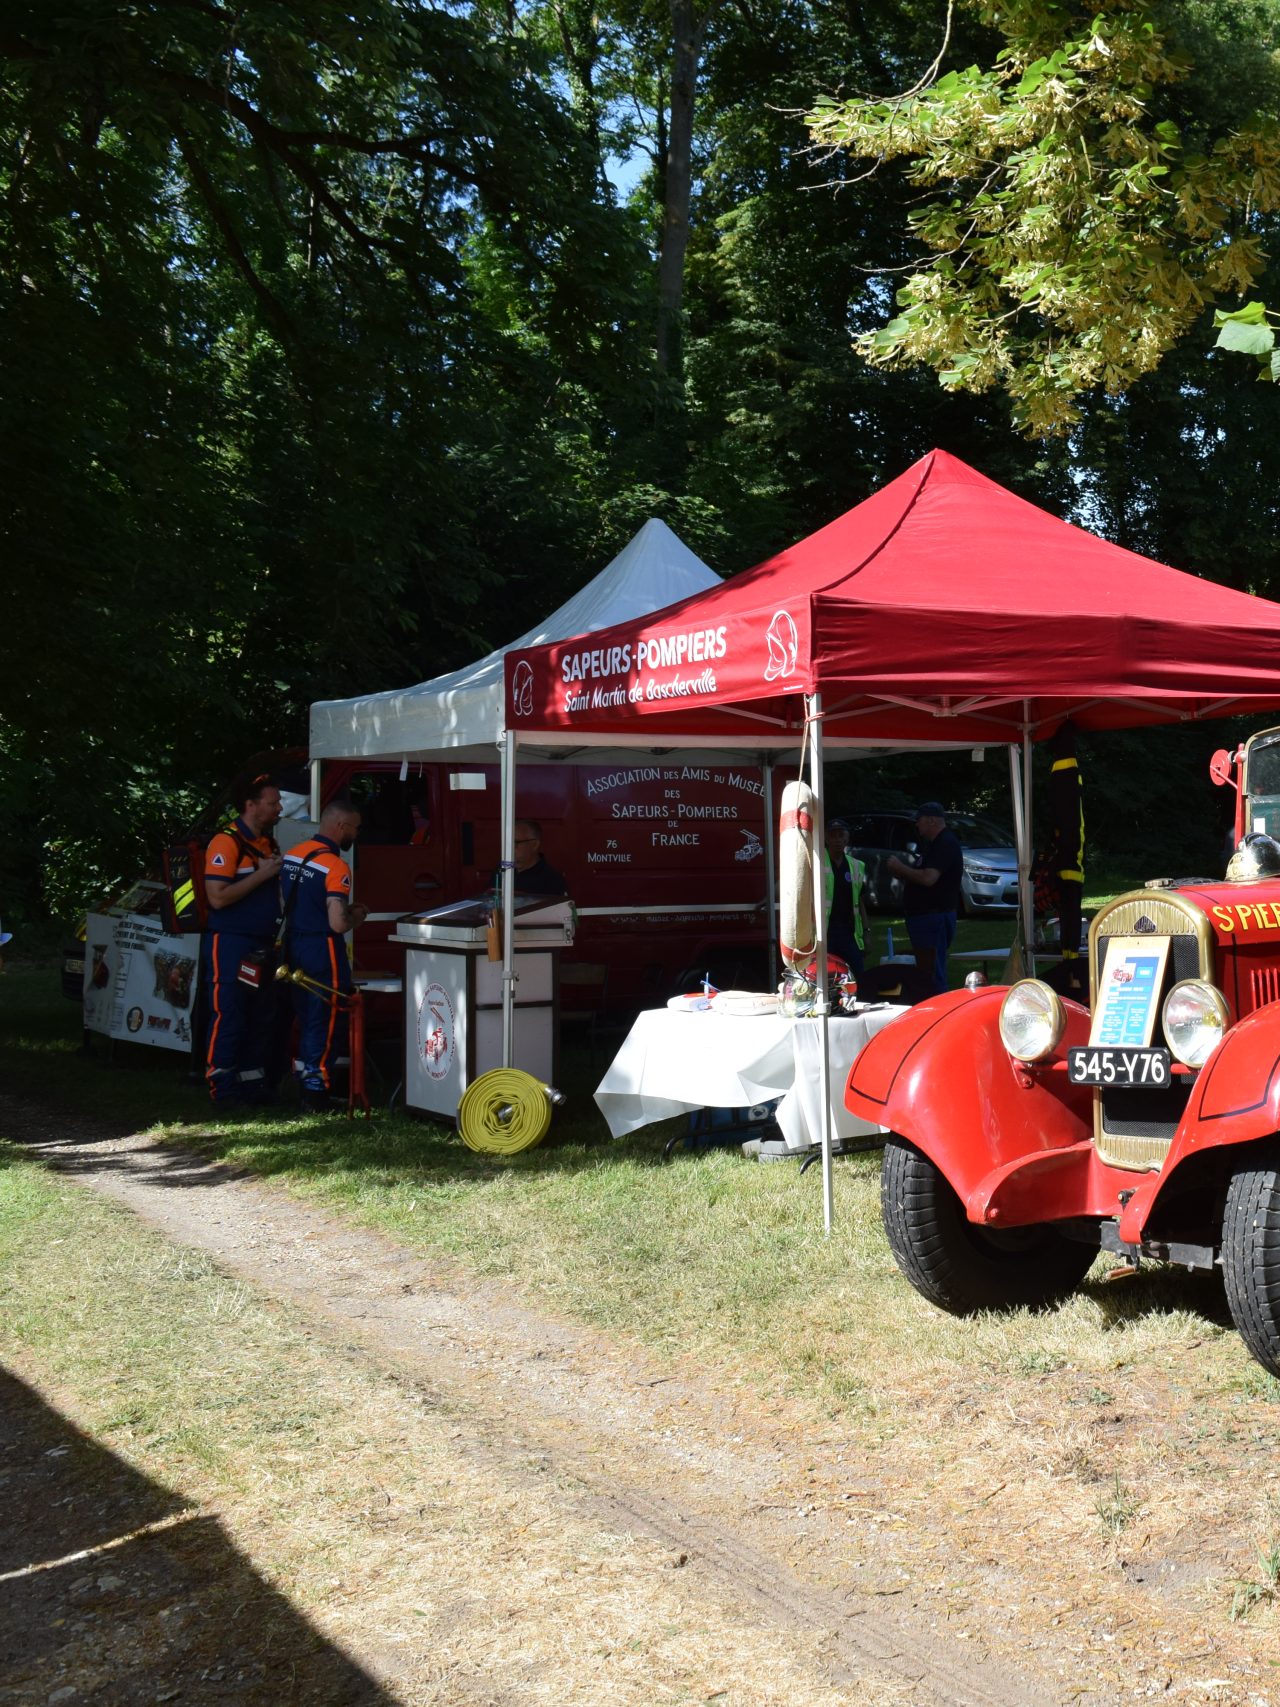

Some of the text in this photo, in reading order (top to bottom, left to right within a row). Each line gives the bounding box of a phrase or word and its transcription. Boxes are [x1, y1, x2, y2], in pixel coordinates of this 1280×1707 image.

[561, 625, 728, 683] SAPEURS-POMPIERS
[563, 689, 590, 713] Saint
[591, 683, 626, 708] Martin
[628, 678, 644, 703] de
[587, 768, 661, 797] ASSOCIATION
[663, 770, 680, 780] DES
[681, 765, 710, 782] AMIS
[714, 774, 726, 784] DU
[664, 789, 681, 799] DES
[667, 820, 679, 829] DE
[606, 839, 618, 849] 76
[651, 832, 700, 847] FRANCE
[587, 851, 632, 863] MONTVILLE
[283, 863, 315, 879] PROTTION
[1073, 1051, 1166, 1084] 545-Y76
